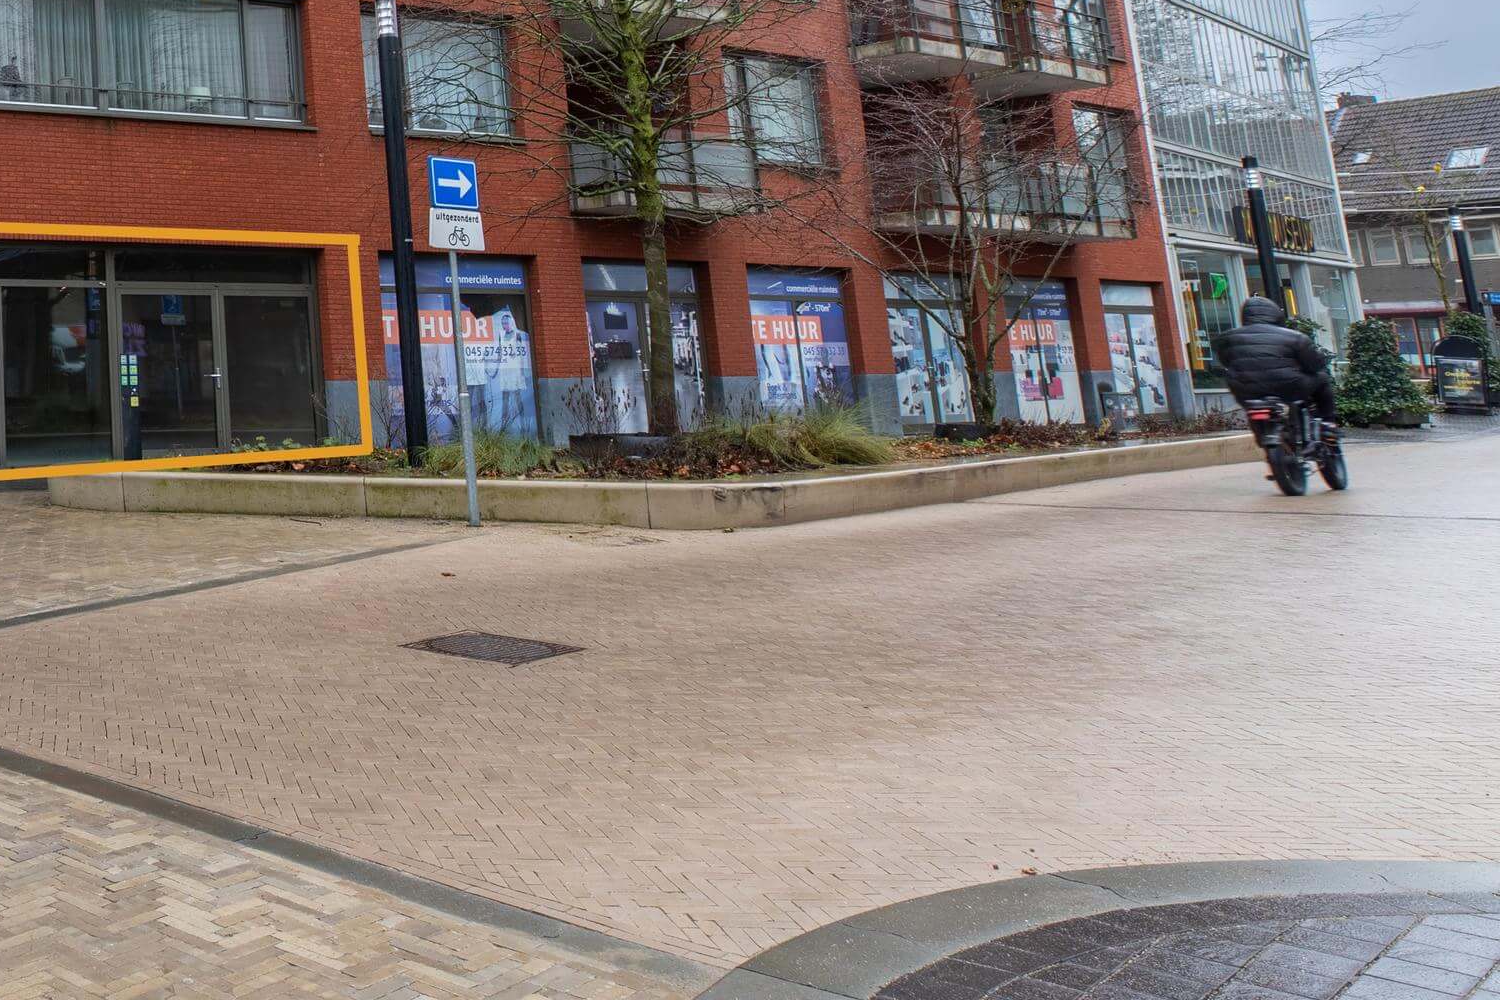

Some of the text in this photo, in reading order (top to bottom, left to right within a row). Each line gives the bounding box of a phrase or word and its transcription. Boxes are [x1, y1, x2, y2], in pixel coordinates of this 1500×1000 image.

[436, 212, 479, 223] uitgezonderd
[494, 275, 522, 285] ruimtes
[772, 320, 819, 340] HUUR
[1020, 323, 1054, 341] HUUR
[465, 346, 482, 357] 045
